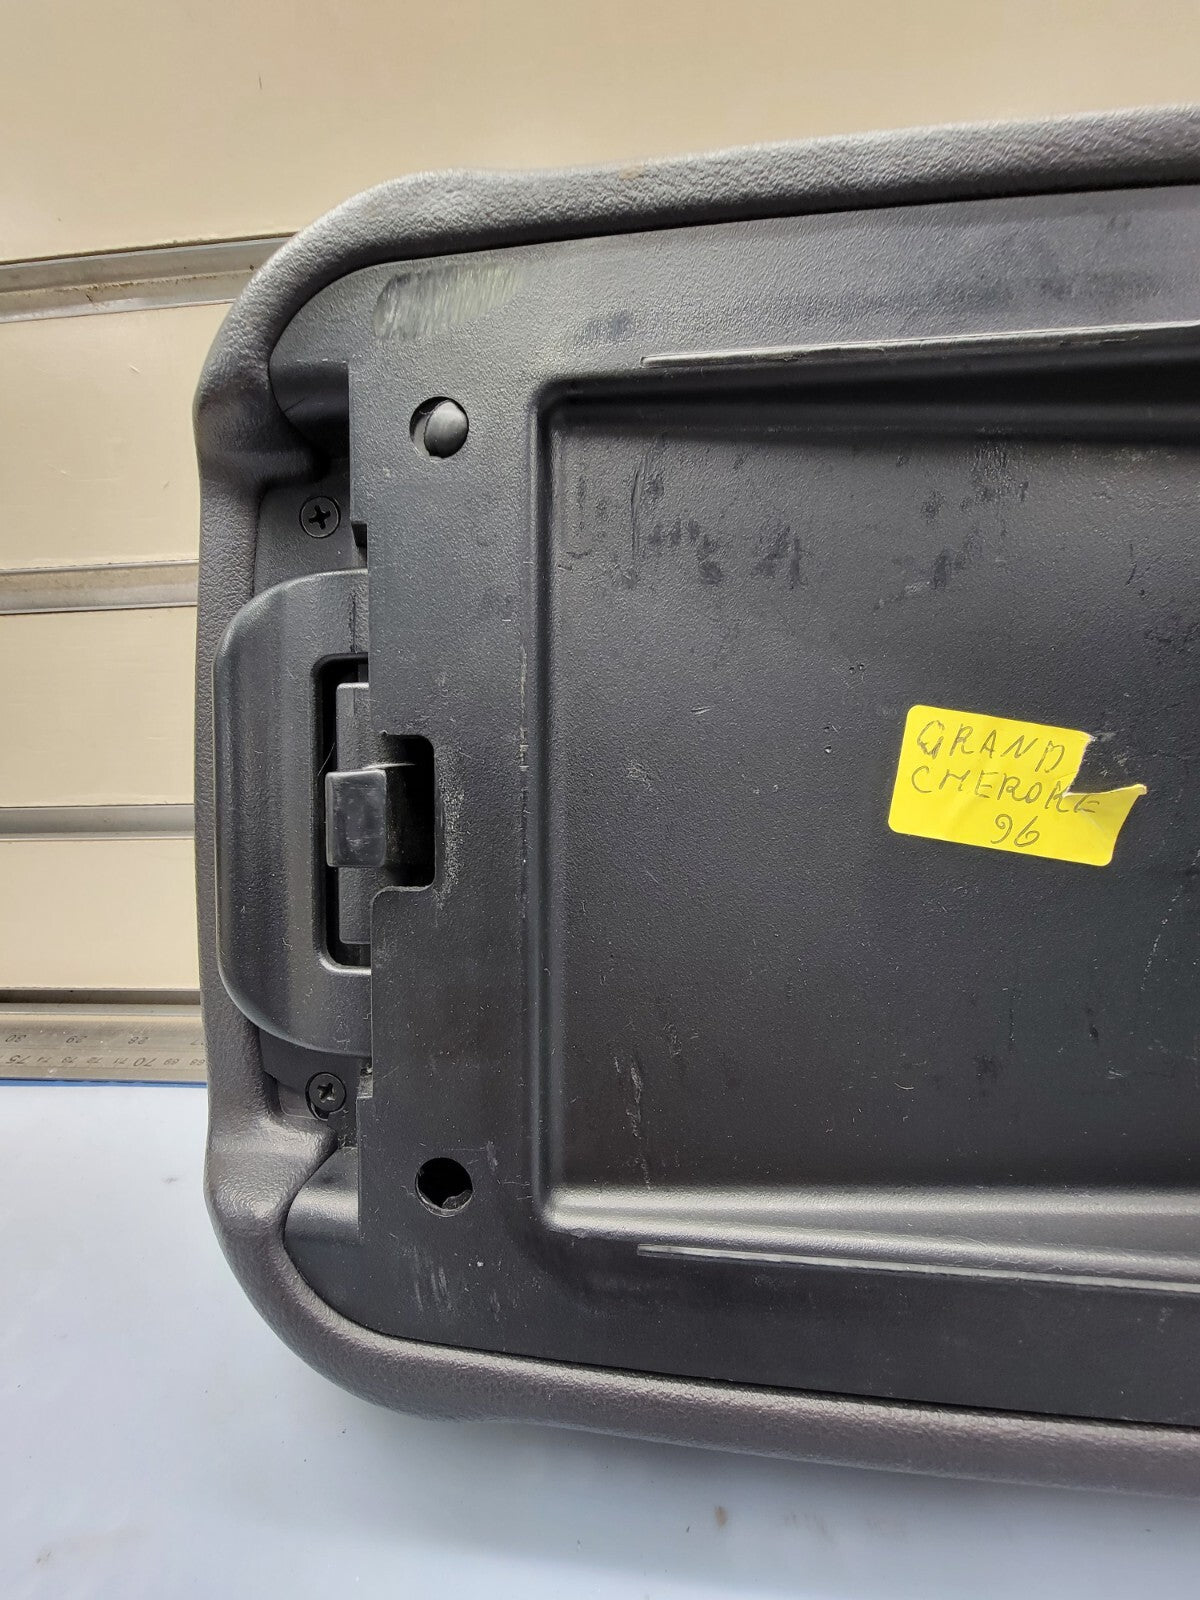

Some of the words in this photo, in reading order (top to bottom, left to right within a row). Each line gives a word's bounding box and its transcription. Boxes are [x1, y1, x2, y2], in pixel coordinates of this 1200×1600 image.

[916, 719, 1066, 774] GRAND
[989, 813, 1041, 848] 96
[5, 1034, 27, 1043] 30
[65, 1035, 88, 1044] 29
[127, 1036, 149, 1045] 28
[5, 1055, 31, 1065] 75
[133, 1057, 157, 1067] 70
